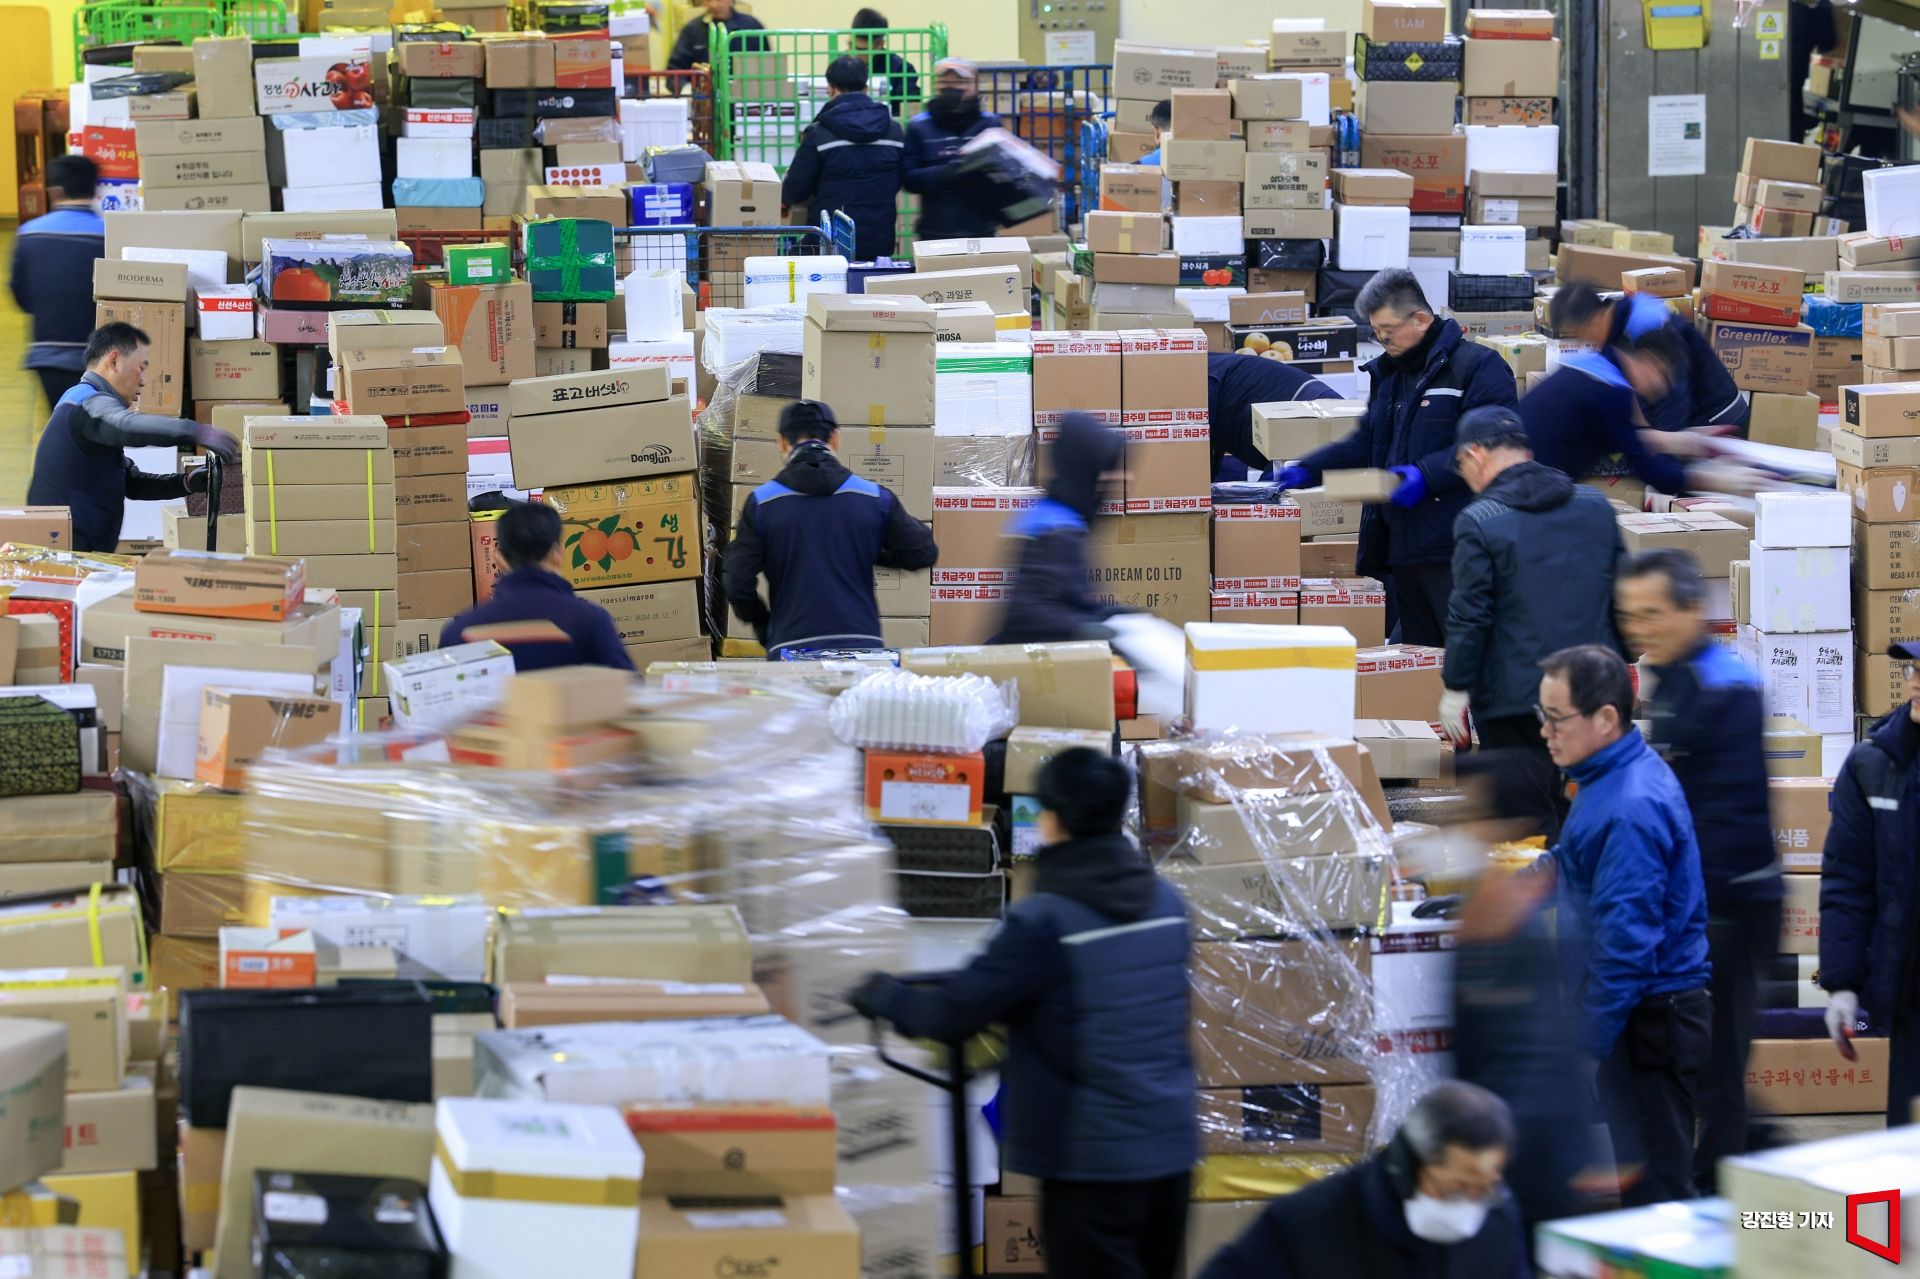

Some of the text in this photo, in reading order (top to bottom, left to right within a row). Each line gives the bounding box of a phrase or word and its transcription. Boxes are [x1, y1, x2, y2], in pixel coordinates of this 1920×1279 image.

[1412, 155, 1439, 170] 소포
[117, 274, 164, 283] BIODERMA
[1758, 281, 1780, 294] 소포
[946, 289, 973, 300] 과일꾼
[1718, 328, 1789, 345] Greenflex
[1721, 357, 1738, 365] 1945
[553, 384, 617, 402] 표고버섯
[645, 485, 651, 493] 4
[934, 498, 968, 508] 취급주의
[1164, 498, 1196, 508] 취급주의
[942, 572, 975, 582] 취급주의
[1105, 567, 1142, 581] DREAM
[1146, 567, 1160, 580] CO
[1163, 567, 1182, 581] LTD
[193, 578, 213, 589] EMS
[939, 589, 971, 599] 취급주의
[1146, 593, 1159, 607] OF
[1773, 828, 1810, 848] 식품
